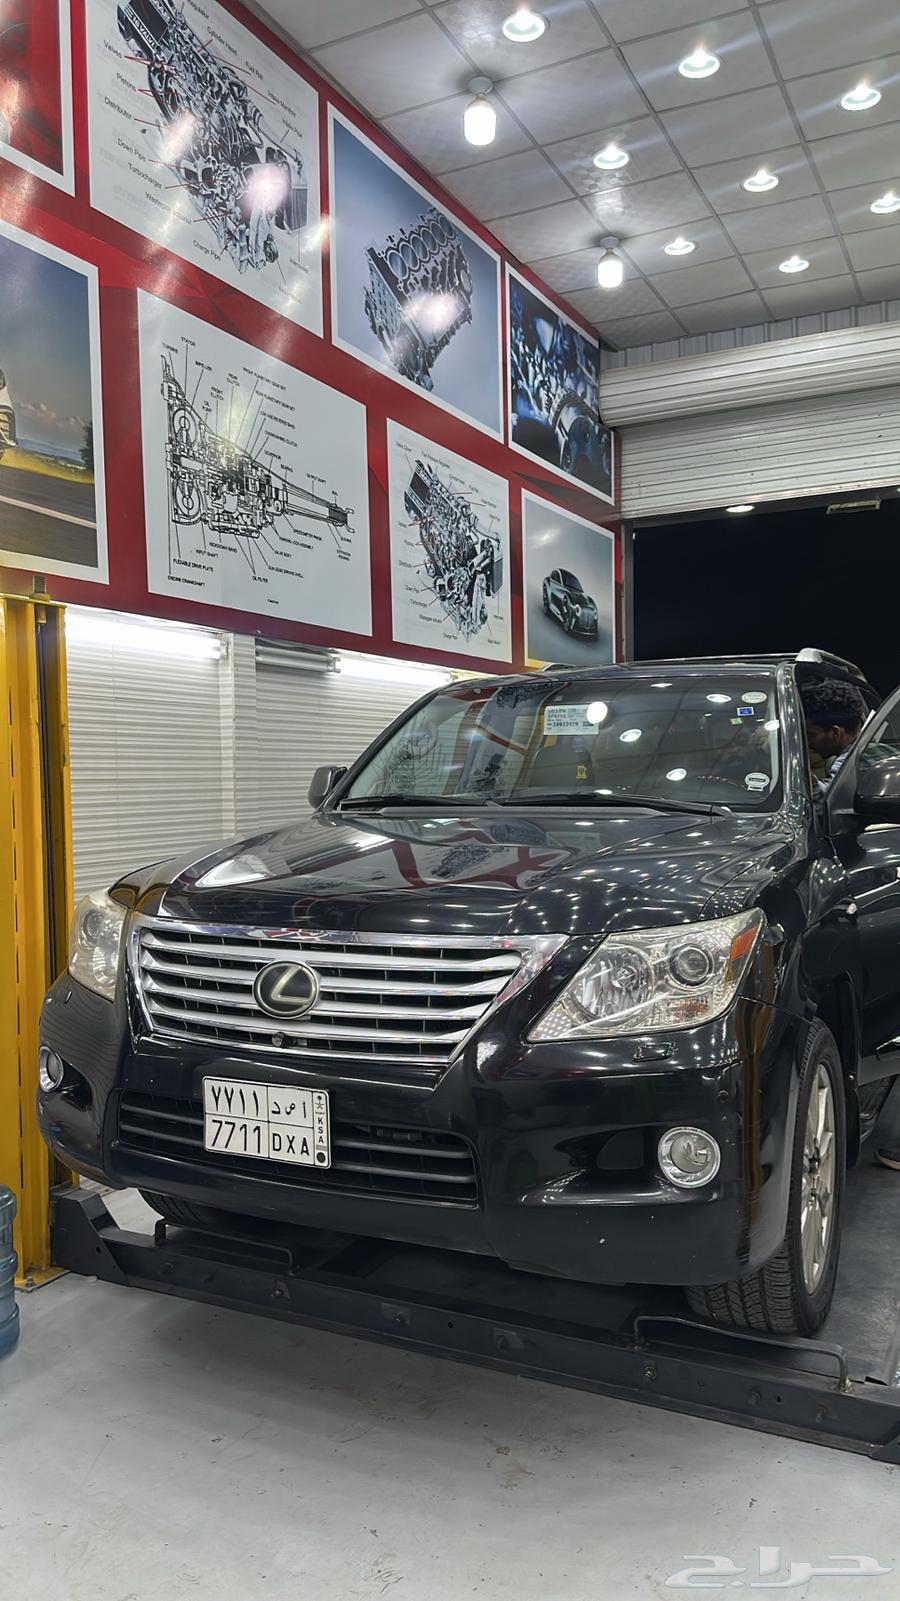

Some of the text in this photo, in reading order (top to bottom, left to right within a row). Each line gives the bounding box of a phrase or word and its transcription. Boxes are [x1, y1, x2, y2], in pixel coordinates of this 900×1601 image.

[116, 72, 137, 92] Pistons
[103, 96, 133, 121] Distributor
[116, 137, 134, 154] Down
[128, 162, 163, 189] Turbocharger
[211, 1084, 259, 1117] ٧٧١١
[211, 1118, 310, 1156] 7711 DXA
